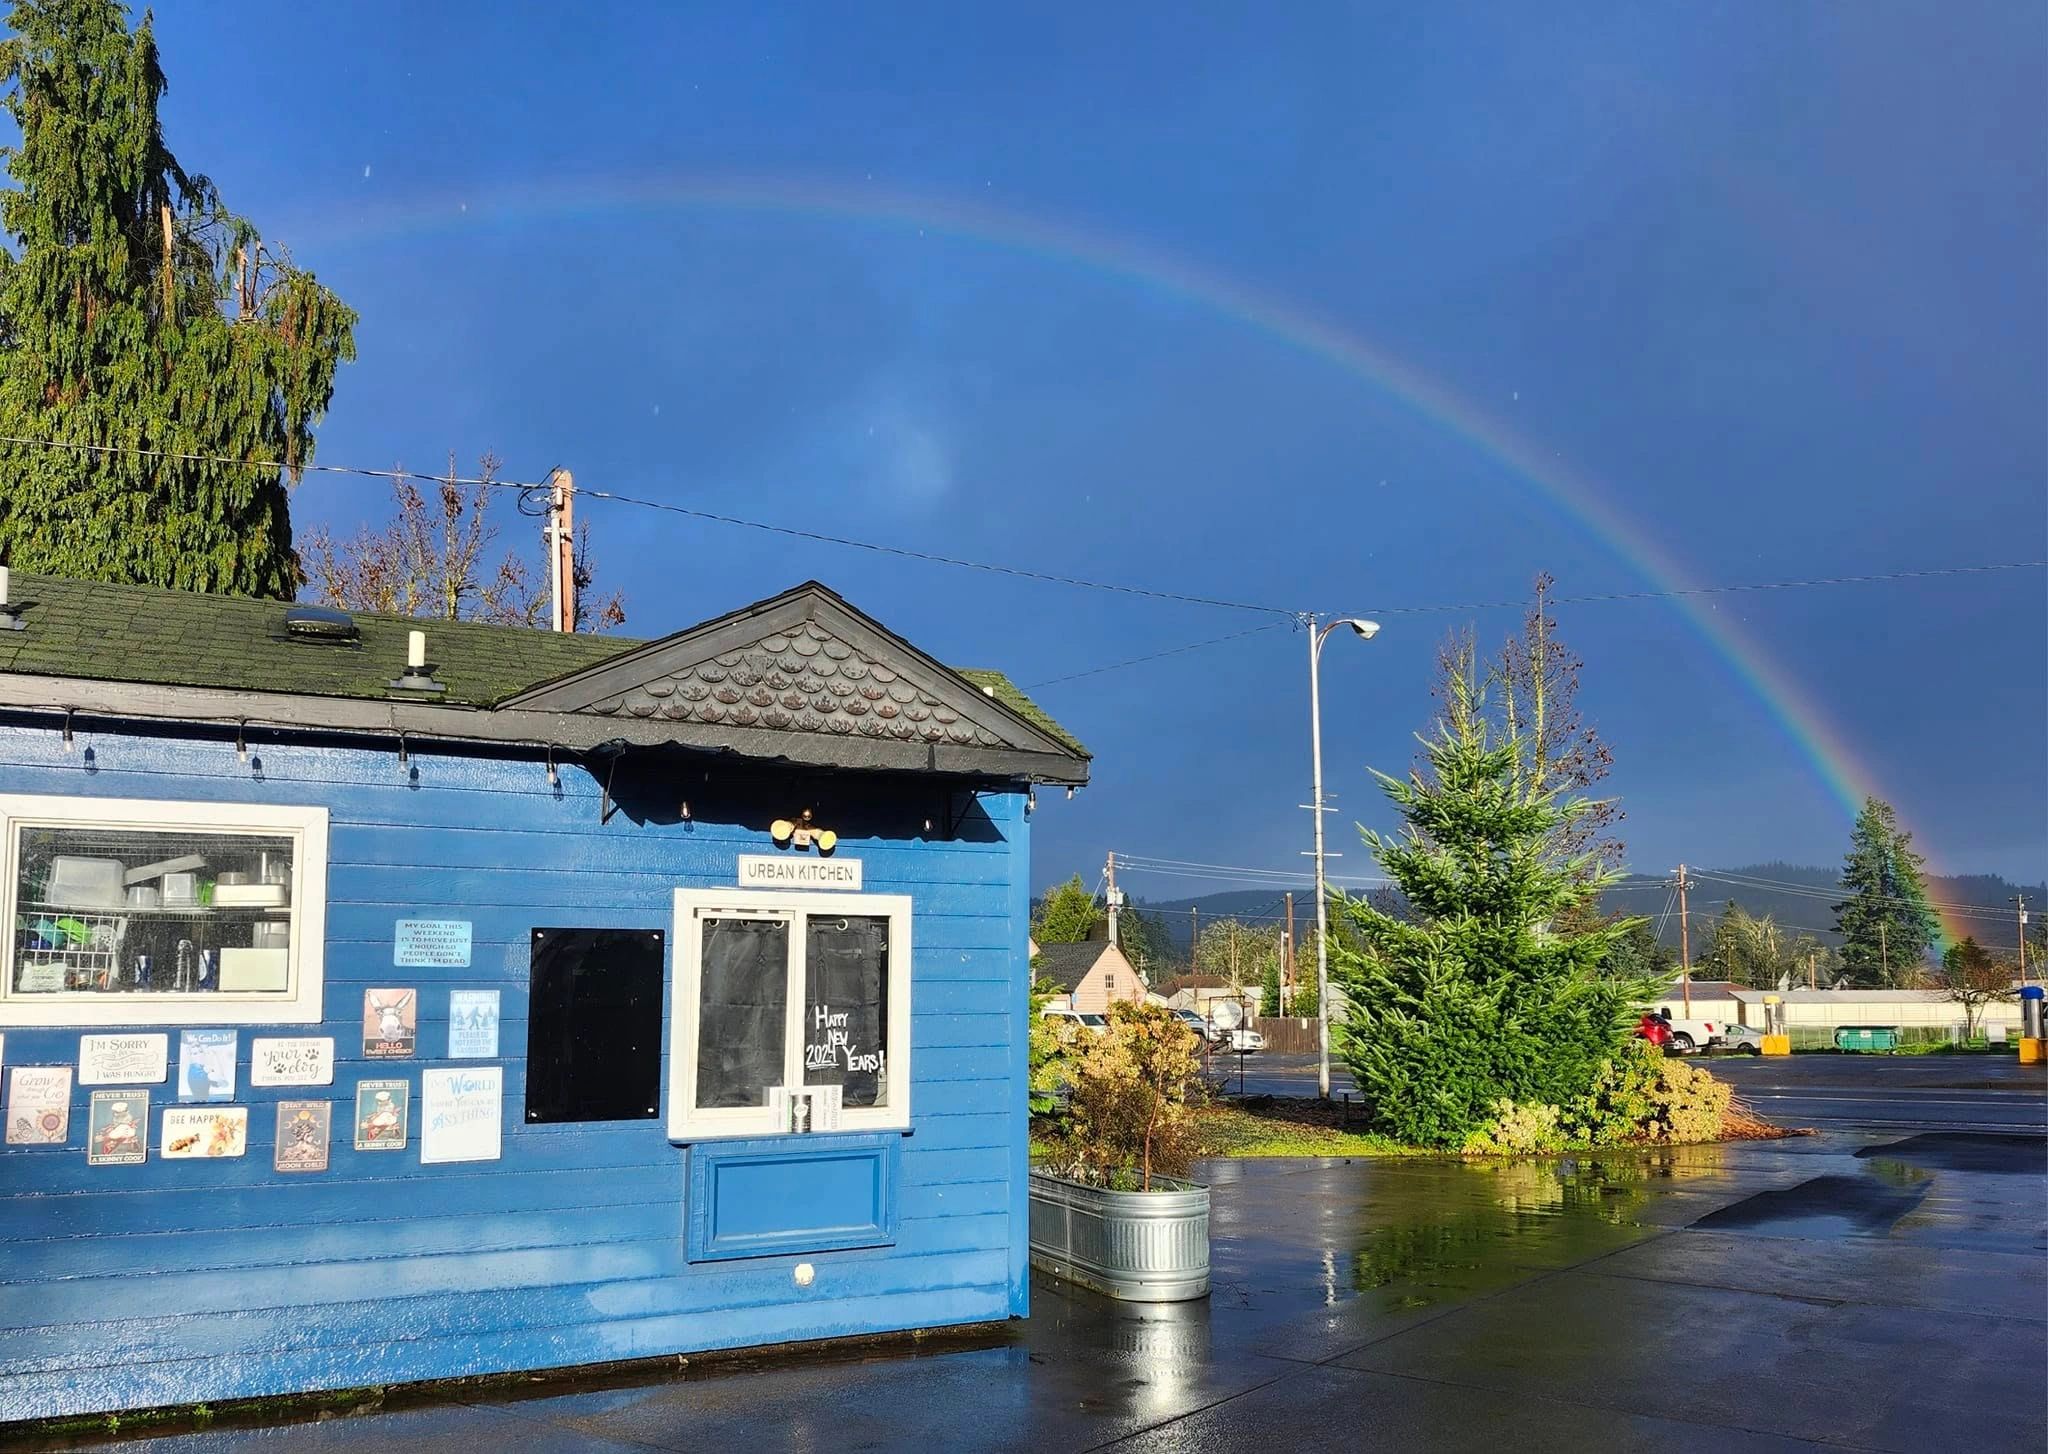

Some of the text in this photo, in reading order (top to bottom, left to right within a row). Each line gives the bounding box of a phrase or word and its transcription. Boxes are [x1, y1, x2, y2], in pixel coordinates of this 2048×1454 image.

[748, 863, 854, 881] URBAN KITCHEN
[186, 1032, 198, 1043] We
[198, 1034, 213, 1043] Can
[212, 1034, 222, 1043] Do
[90, 1039, 106, 1051] I'M
[805, 1043, 837, 1066] 2024
[288, 1058, 322, 1079] dog
[19, 1073, 54, 1086] Grow
[170, 1114, 220, 1124] BEE HAPPY
